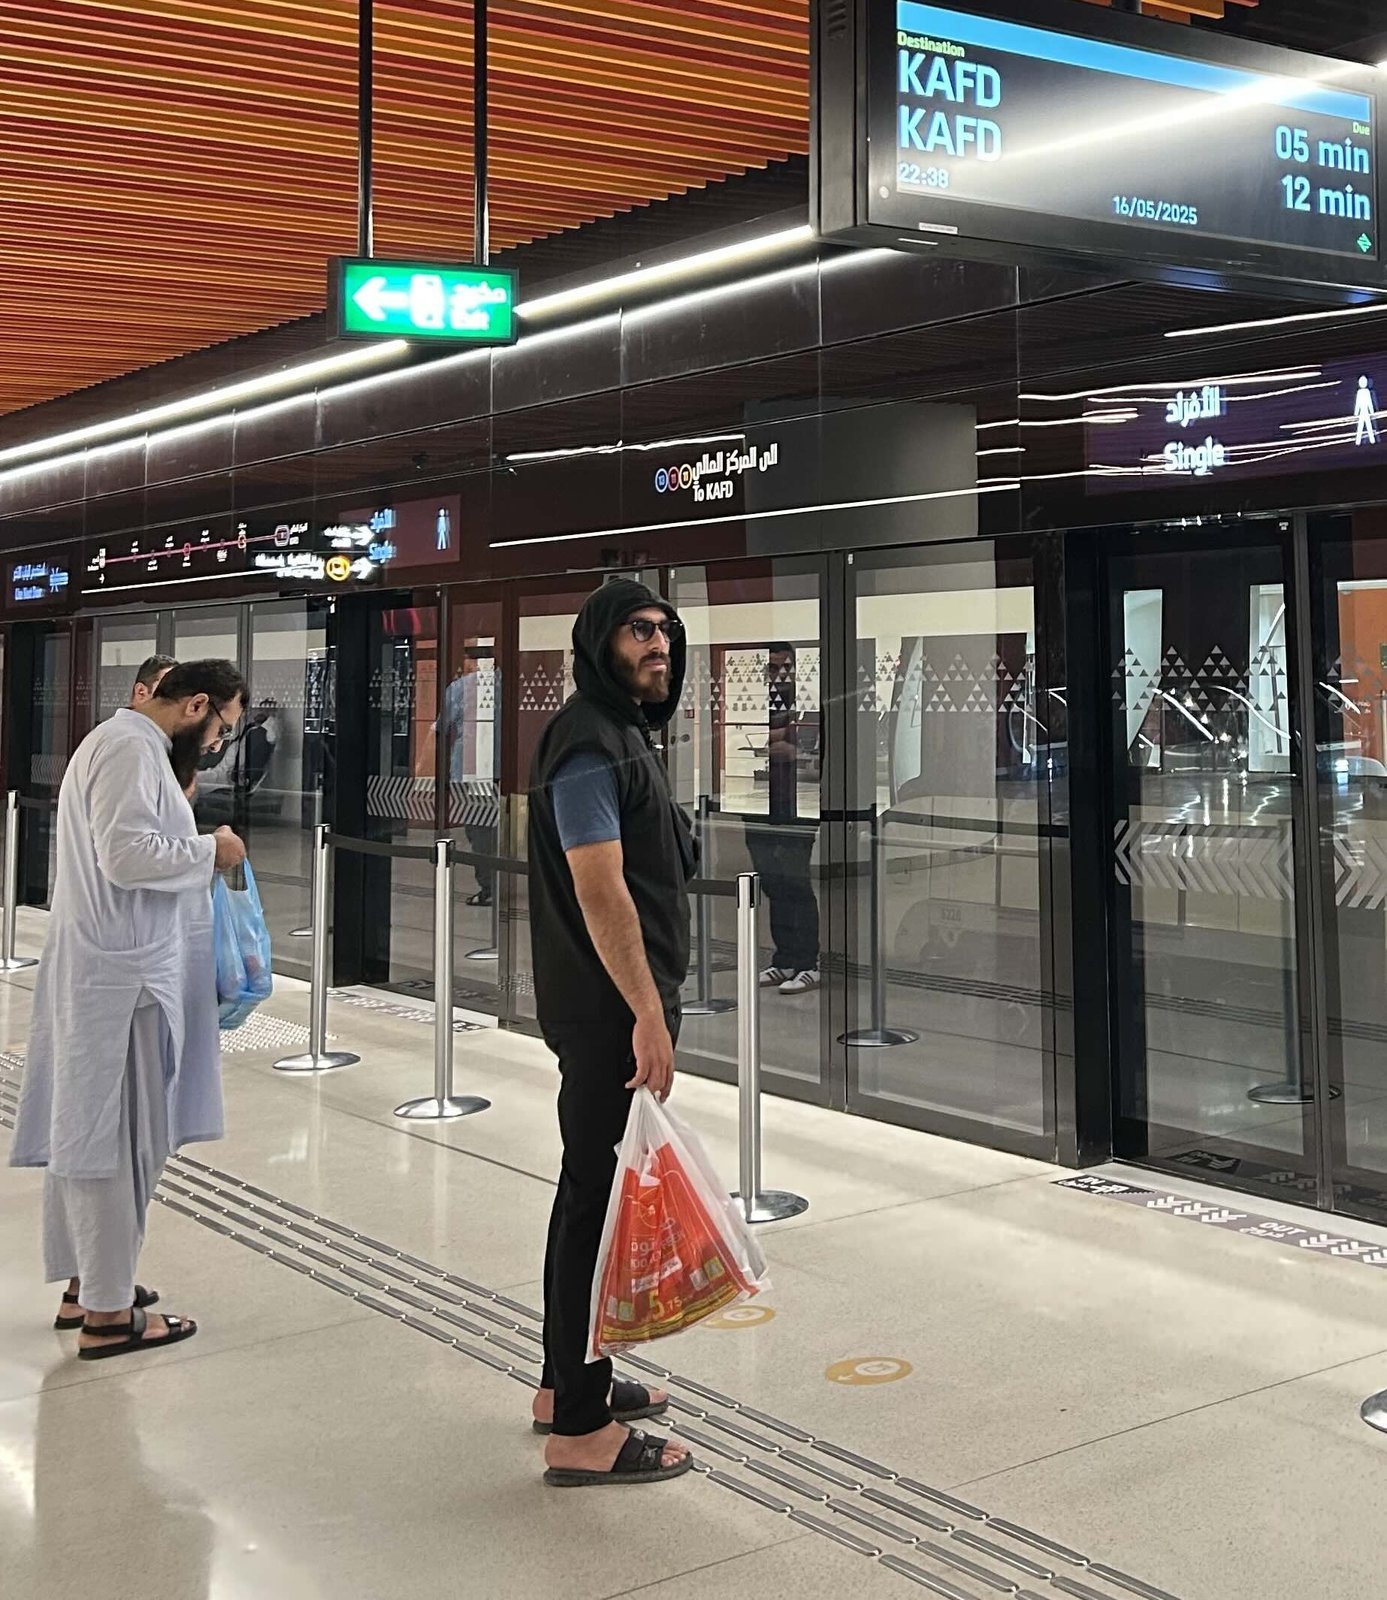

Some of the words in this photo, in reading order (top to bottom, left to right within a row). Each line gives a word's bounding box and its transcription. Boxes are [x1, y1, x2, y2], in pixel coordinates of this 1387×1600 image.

[897, 31, 965, 58] Destination
[899, 50, 1001, 108] KAFD
[899, 105, 1002, 162] KAFD
[1352, 121, 1371, 136] Due
[1275, 125, 1310, 163] 05
[1318, 137, 1370, 174] min
[899, 162, 949, 189] 22:38
[1112, 195, 1198, 225] 16/05/2025
[1281, 174, 1311, 212] 12
[1319, 184, 1371, 221] min
[725, 446, 757, 476] المركز
[1164, 436, 1226, 476] Single
[692, 483, 705, 502] To
[705, 480, 733, 501] KAFD
[1259, 1222, 1307, 1235] OUT
